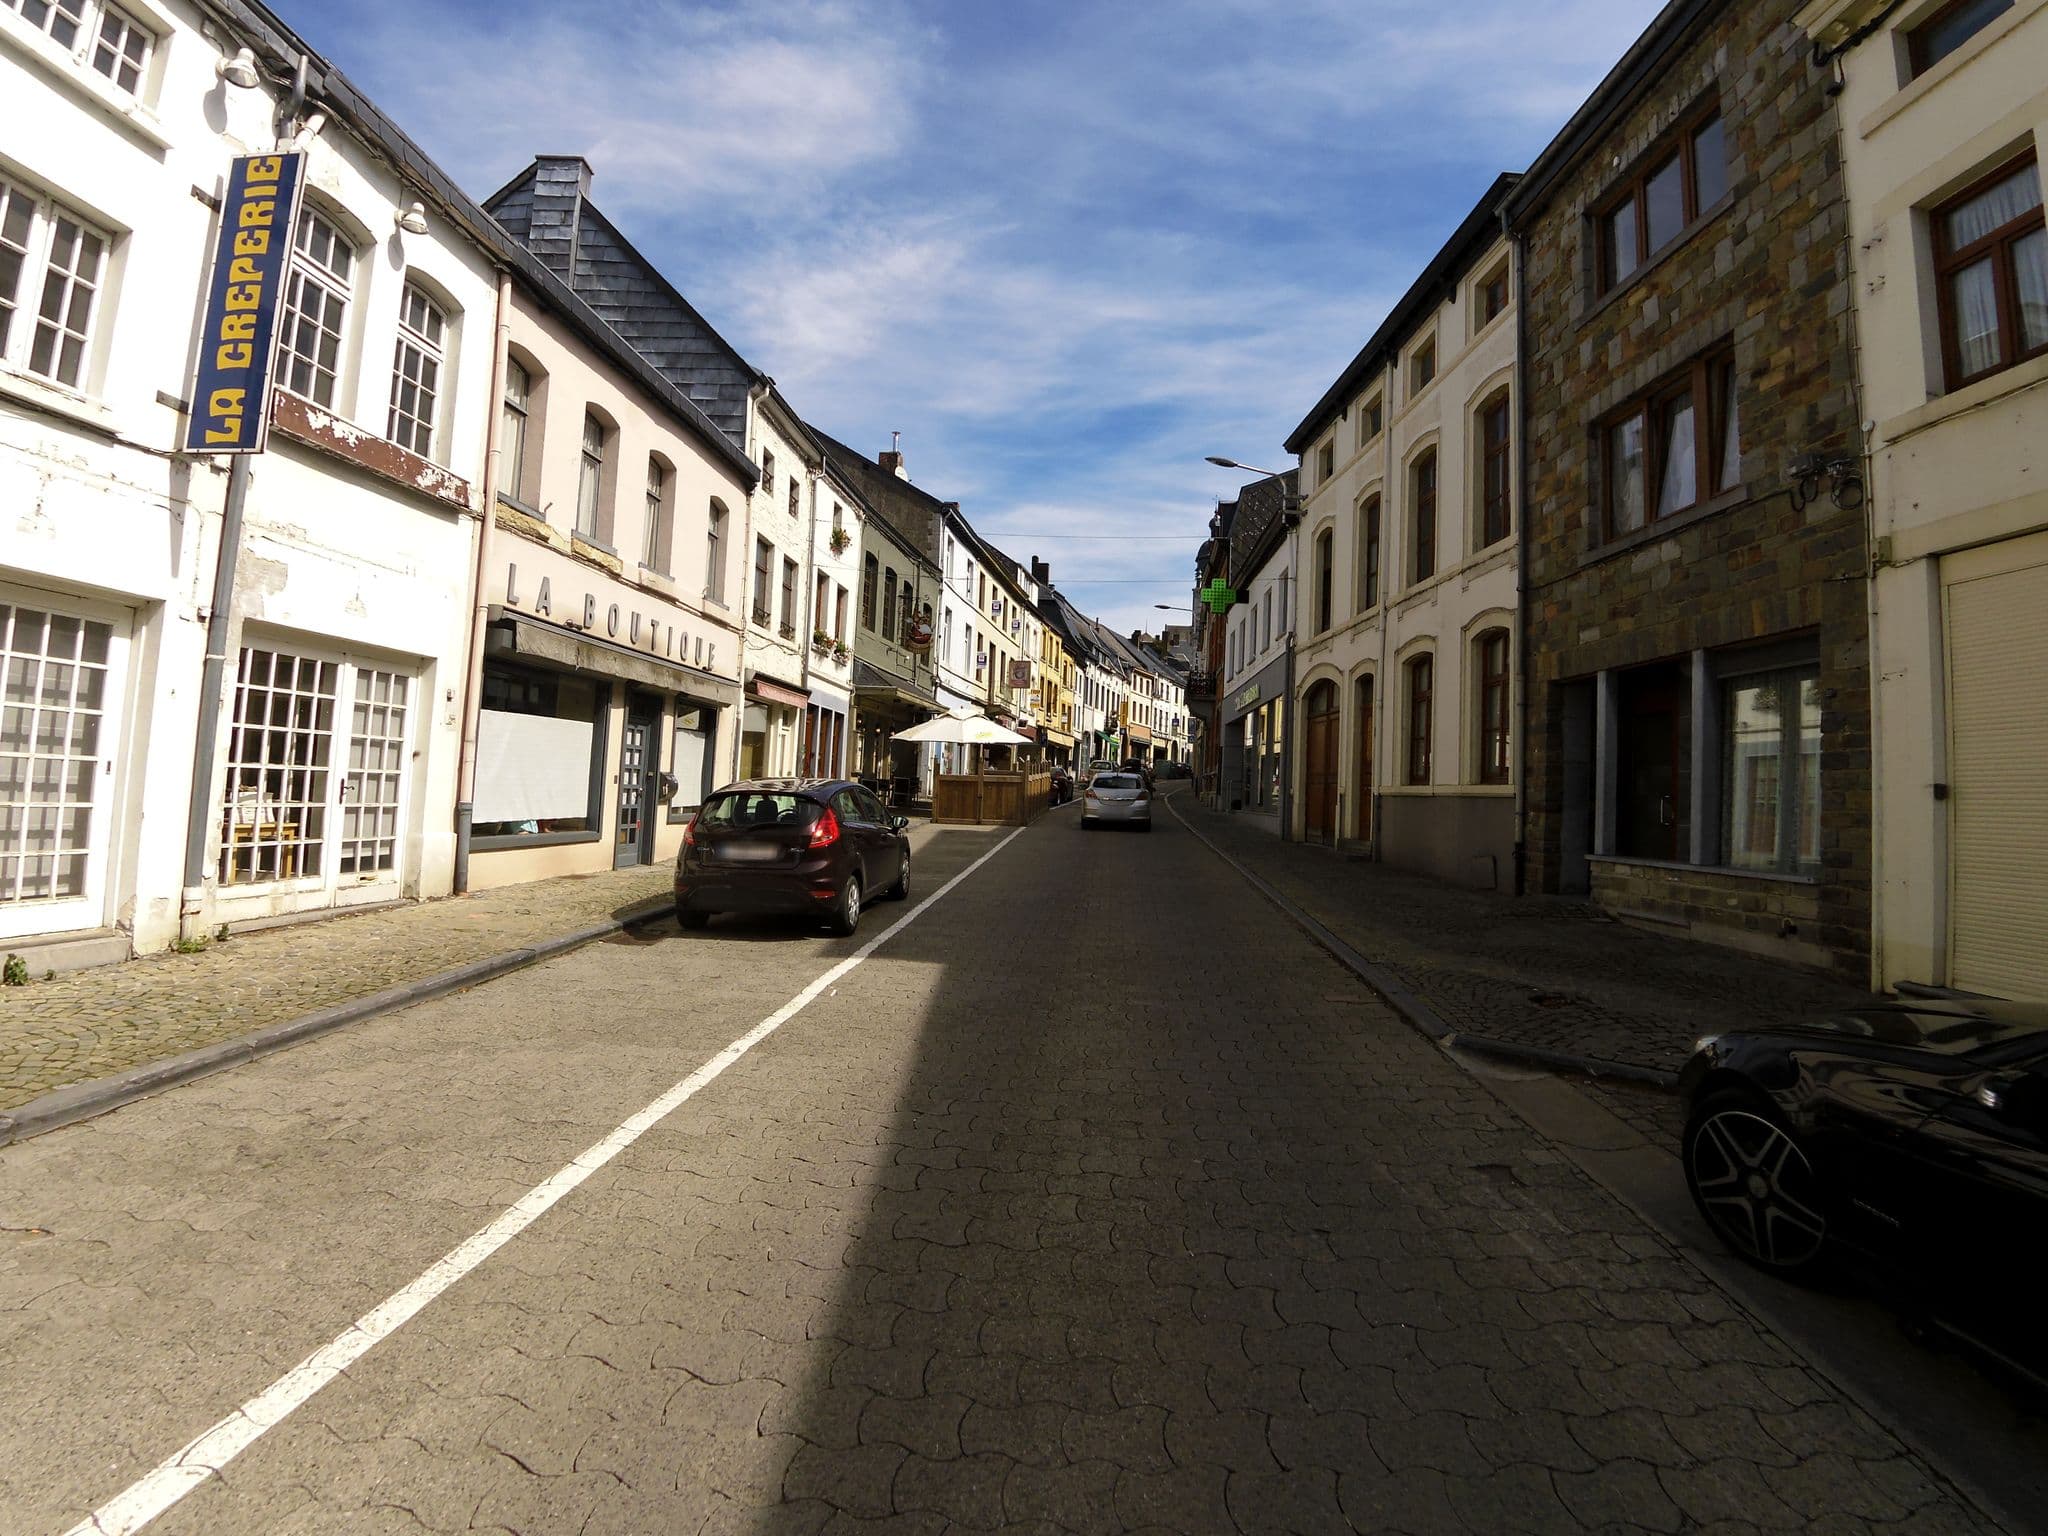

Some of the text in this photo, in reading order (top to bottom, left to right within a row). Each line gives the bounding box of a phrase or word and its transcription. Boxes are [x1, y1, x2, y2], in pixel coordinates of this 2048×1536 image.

[204, 156, 283, 444] LA CREPERIE
[507, 563, 716, 671] LA BOUTIQUE
